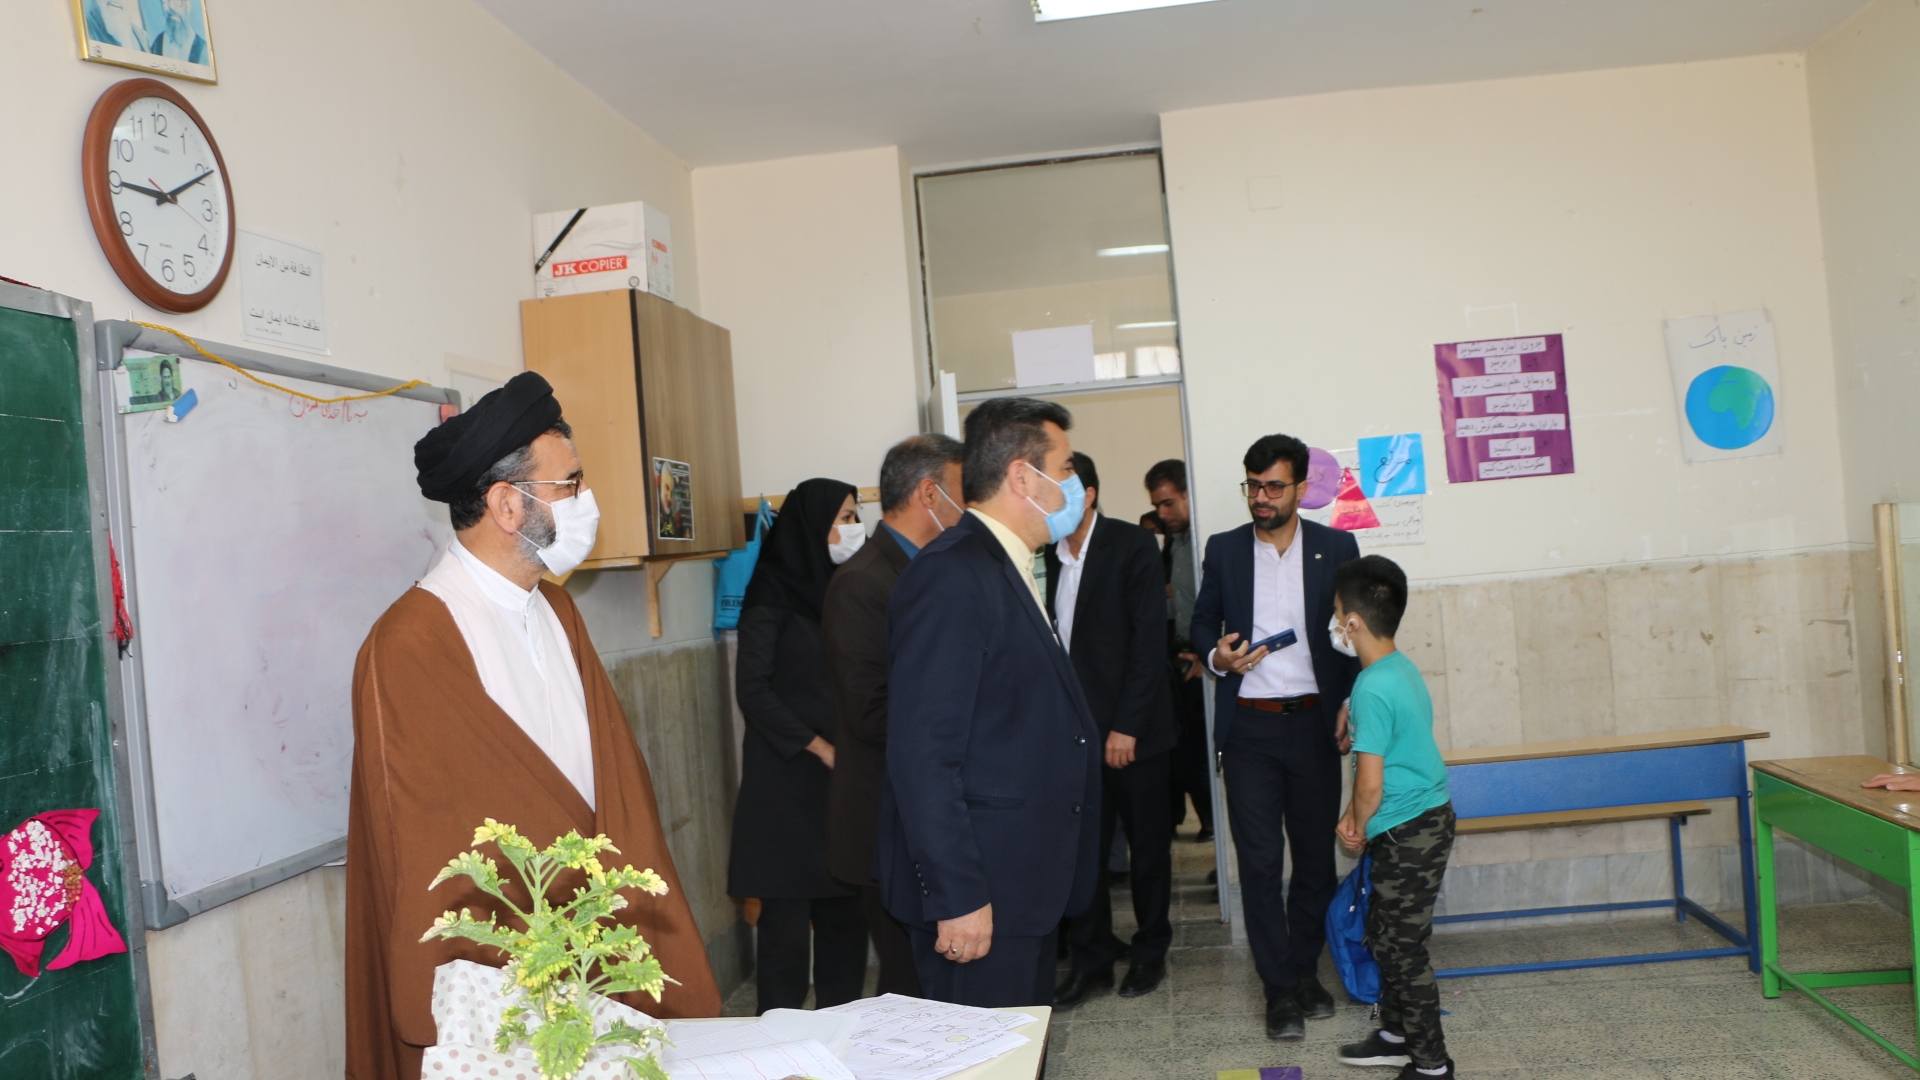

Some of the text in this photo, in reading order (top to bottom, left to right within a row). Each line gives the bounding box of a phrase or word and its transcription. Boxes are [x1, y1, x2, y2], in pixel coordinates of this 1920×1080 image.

[129, 115, 143, 140] 11
[150, 111, 169, 138] 12
[113, 136, 134, 162] 10
[180, 132, 187, 154] 1
[108, 170, 123, 195] 9
[195, 163, 206, 186] 2
[201, 199, 213, 222] 3
[120, 211, 133, 236] 8
[137, 243, 149, 266] 7
[197, 234, 209, 255] 4
[162, 259, 175, 282] 6
[183, 255, 196, 277] 5
[280, 262, 289, 273] من
[554, 257, 623, 276] JK COPIER
[249, 307, 265, 319] است
[1688, 324, 1758, 349] زمین پاک
